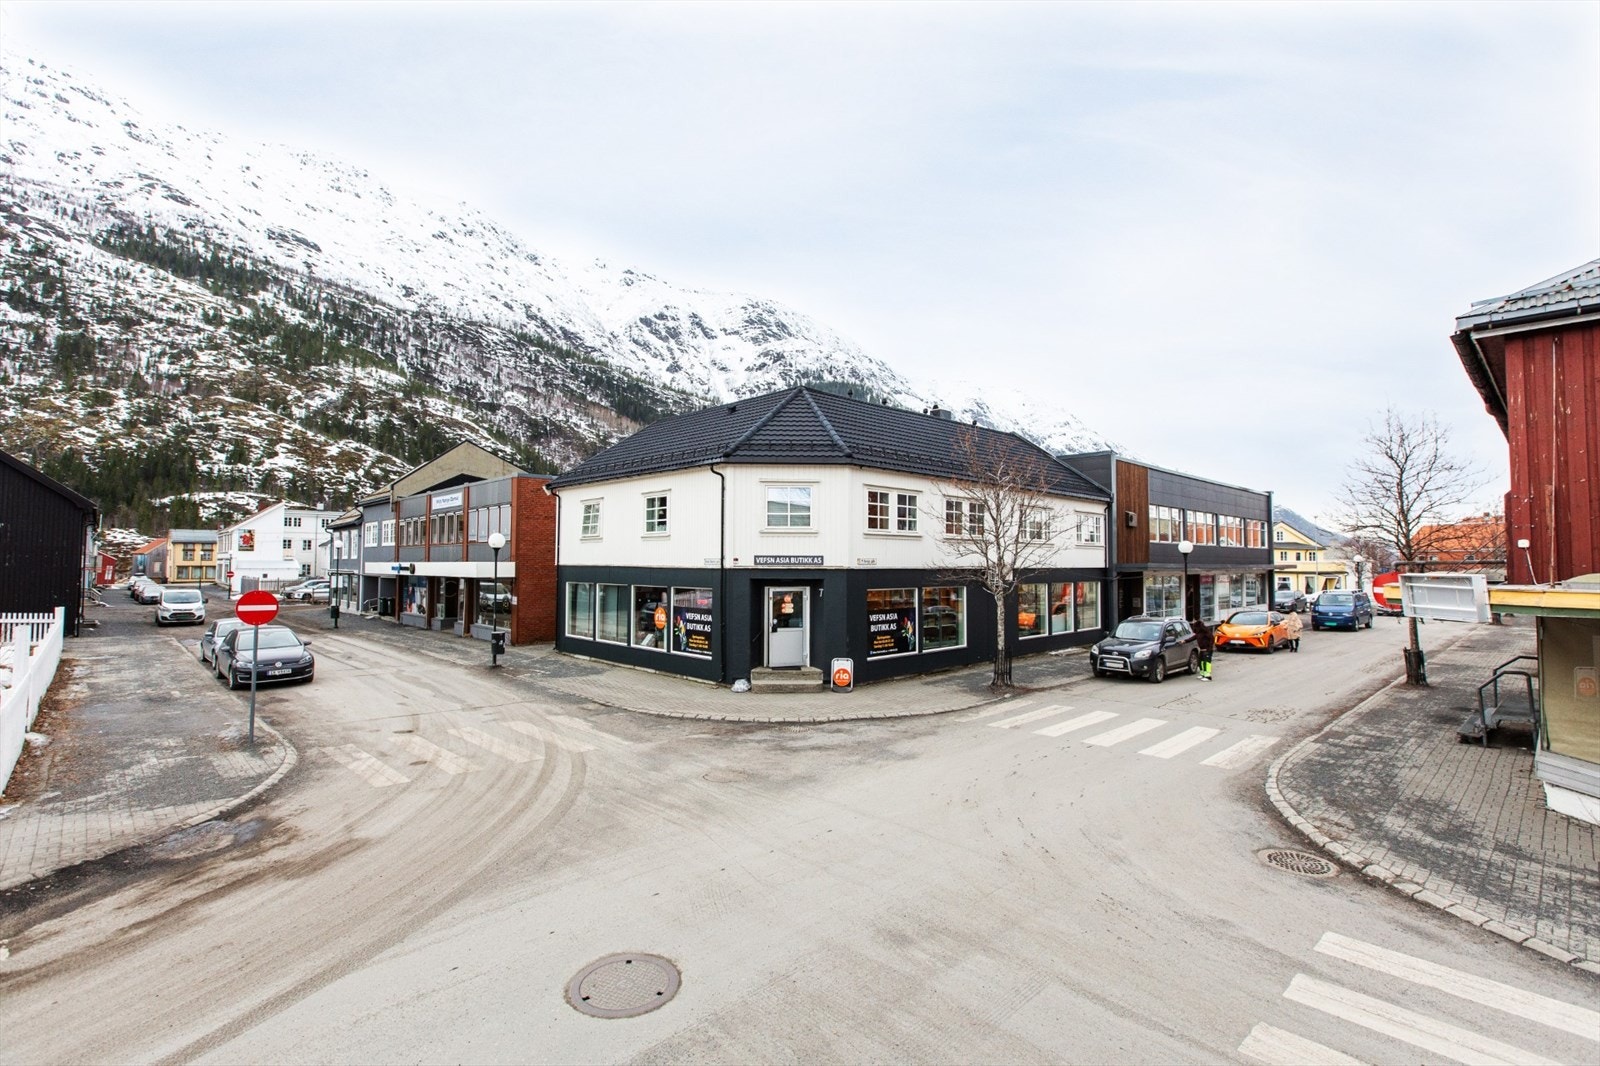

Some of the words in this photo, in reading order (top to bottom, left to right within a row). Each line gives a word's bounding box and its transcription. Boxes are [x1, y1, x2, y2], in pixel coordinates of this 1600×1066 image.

[686, 612, 700, 620] VEFSN
[686, 622, 704, 630] BUTIKK
[870, 624, 889, 632] BUTIKK
[835, 670, 849, 679] ria
